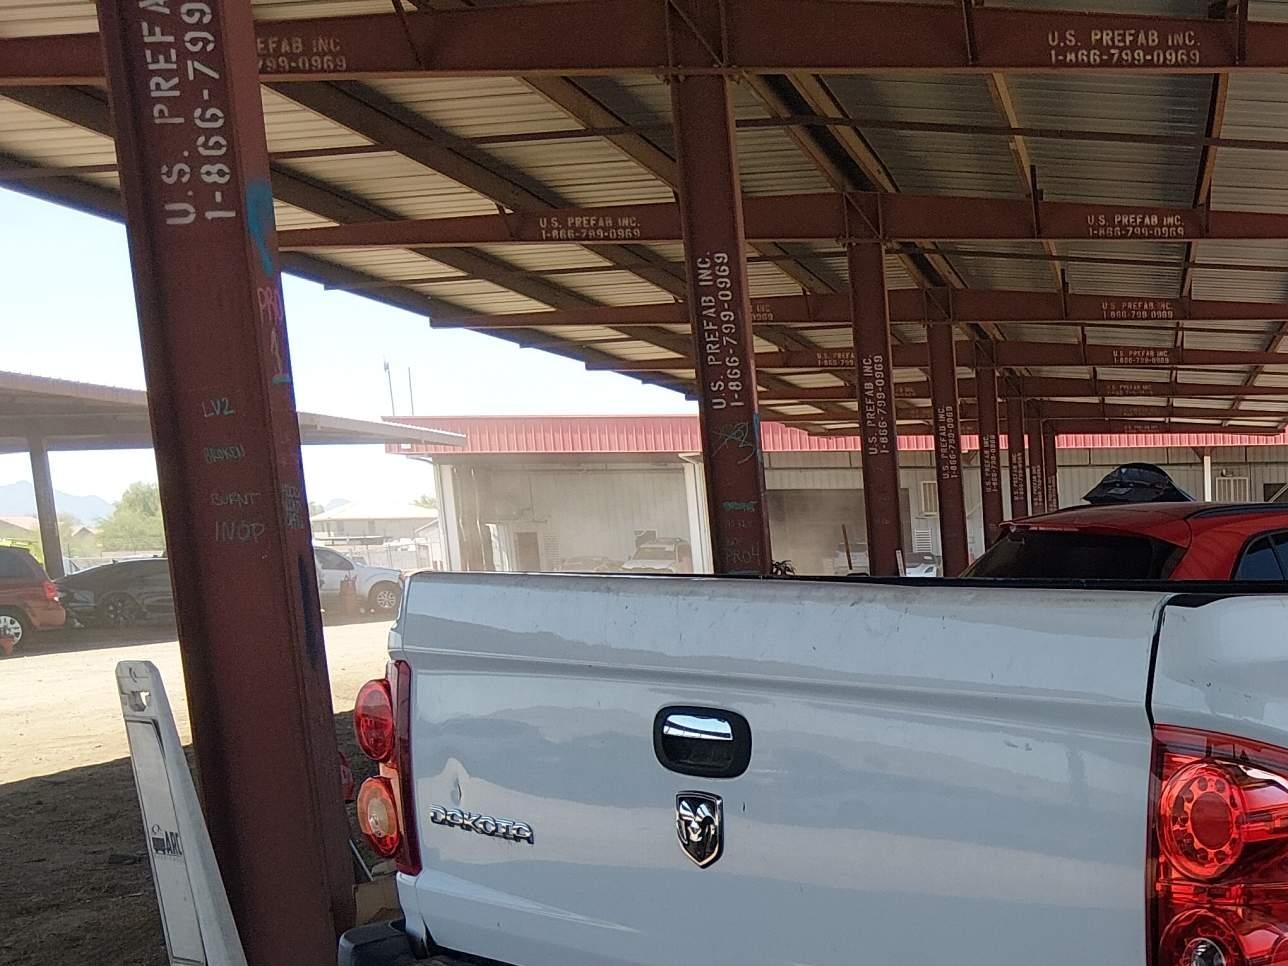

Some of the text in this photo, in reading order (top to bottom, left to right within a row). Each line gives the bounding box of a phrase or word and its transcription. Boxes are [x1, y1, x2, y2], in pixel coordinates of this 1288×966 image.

[1049, 29, 1200, 47] U.S. PREFAB INC.
[1050, 50, 1200, 65] 1-866-799-0969
[161, 150, 196, 225] U.S.
[567, 216, 613, 228] PREFAB
[1114, 214, 1158, 226] PREFAB
[697, 252, 726, 409] U.S. PREFAB INC.
[714, 252, 744, 407] 1-866-799-0969
[864, 382, 876, 427] PREFAB
[214, 521, 265, 544] INOP
[430, 803, 535, 845] DAKOTA
